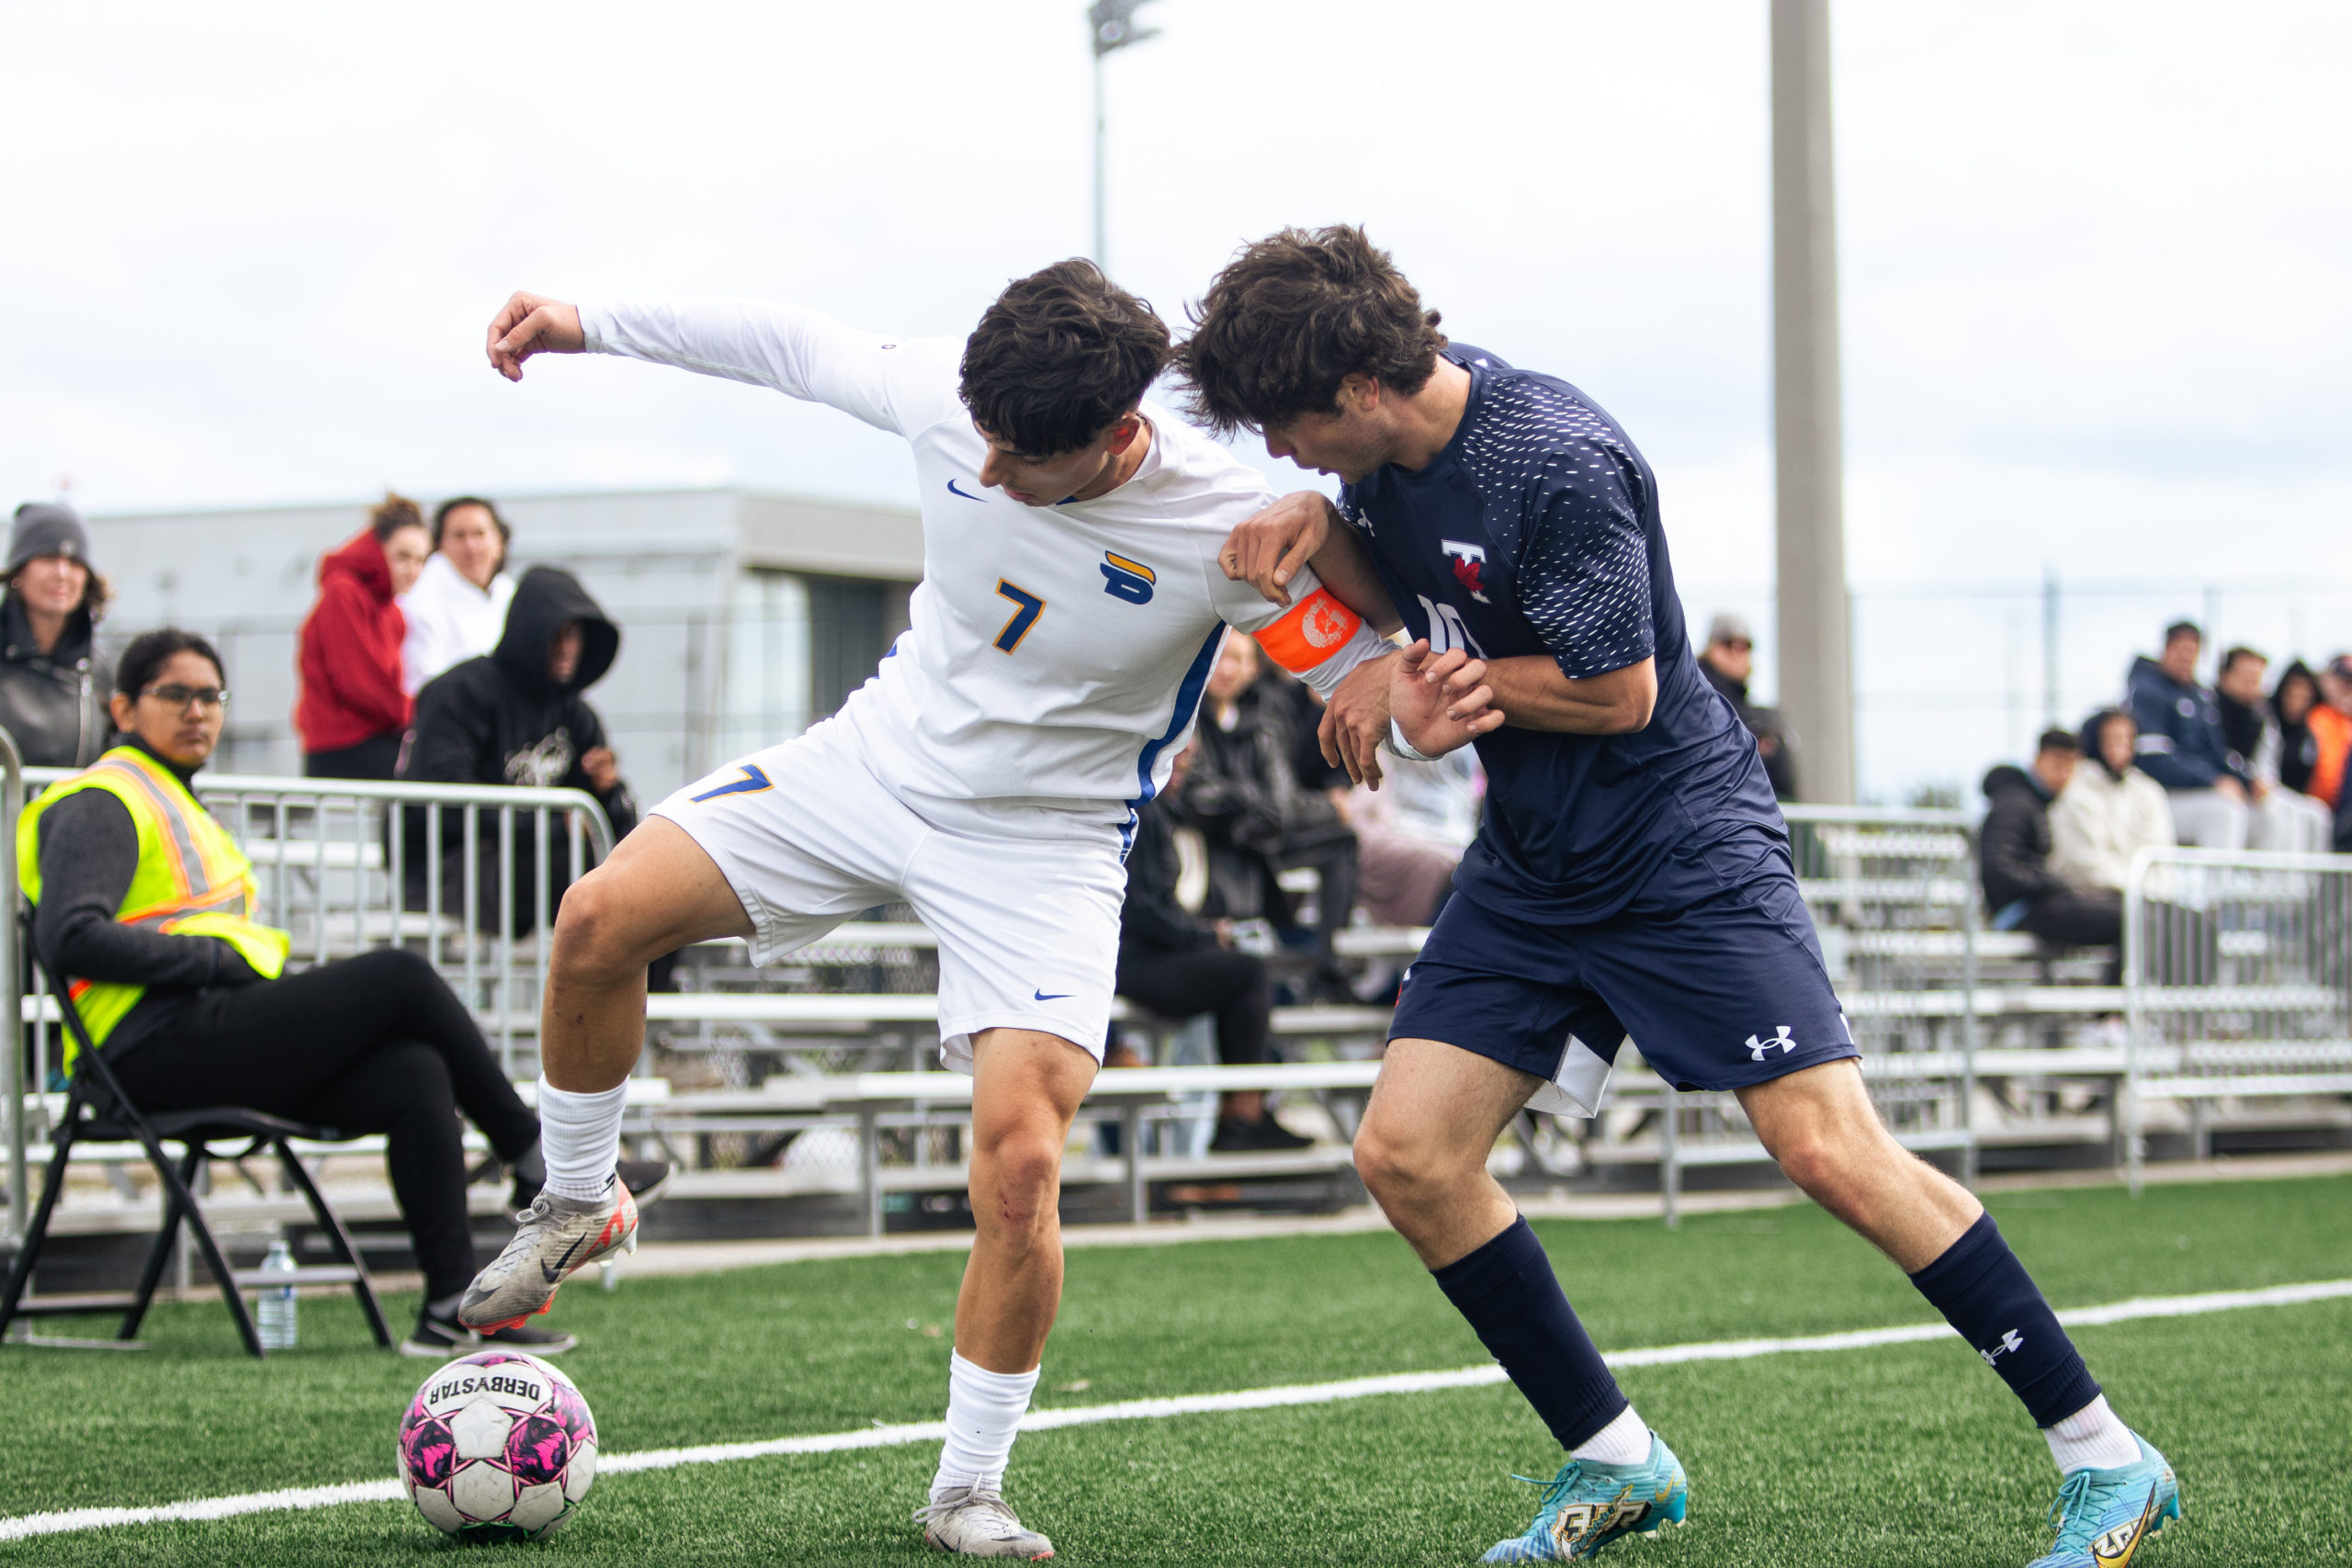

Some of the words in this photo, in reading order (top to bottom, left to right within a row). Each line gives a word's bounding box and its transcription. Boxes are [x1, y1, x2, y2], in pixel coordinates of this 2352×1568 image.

[992, 577, 1046, 656] 7
[687, 762, 775, 804] 7
[430, 1376, 540, 1405] DERBYSTAR
